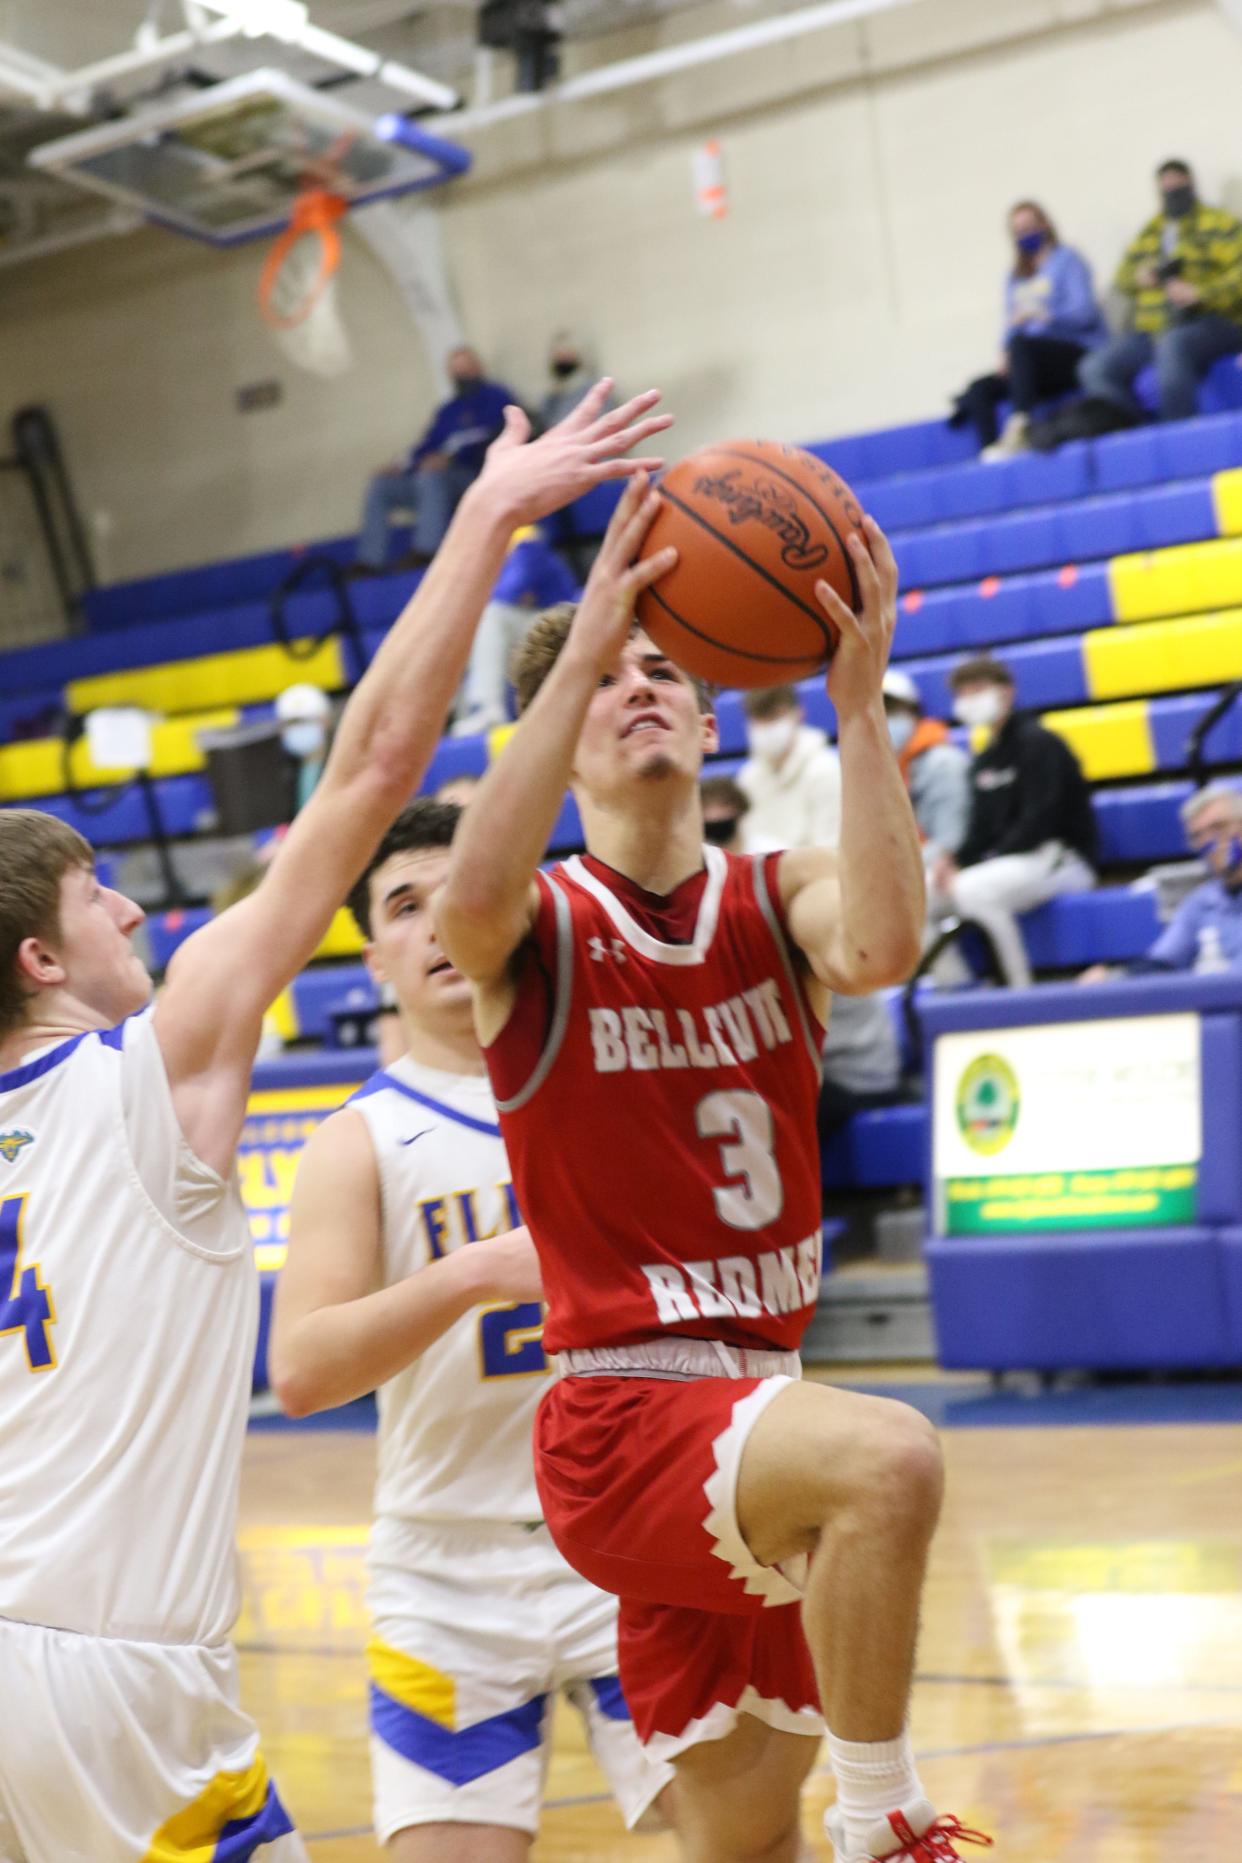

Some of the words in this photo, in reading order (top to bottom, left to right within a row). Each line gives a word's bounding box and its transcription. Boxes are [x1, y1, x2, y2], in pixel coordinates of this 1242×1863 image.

[696, 1088, 784, 1232] 3
[0, 1190, 58, 1374] 4
[640, 1228, 823, 1326] REDME
